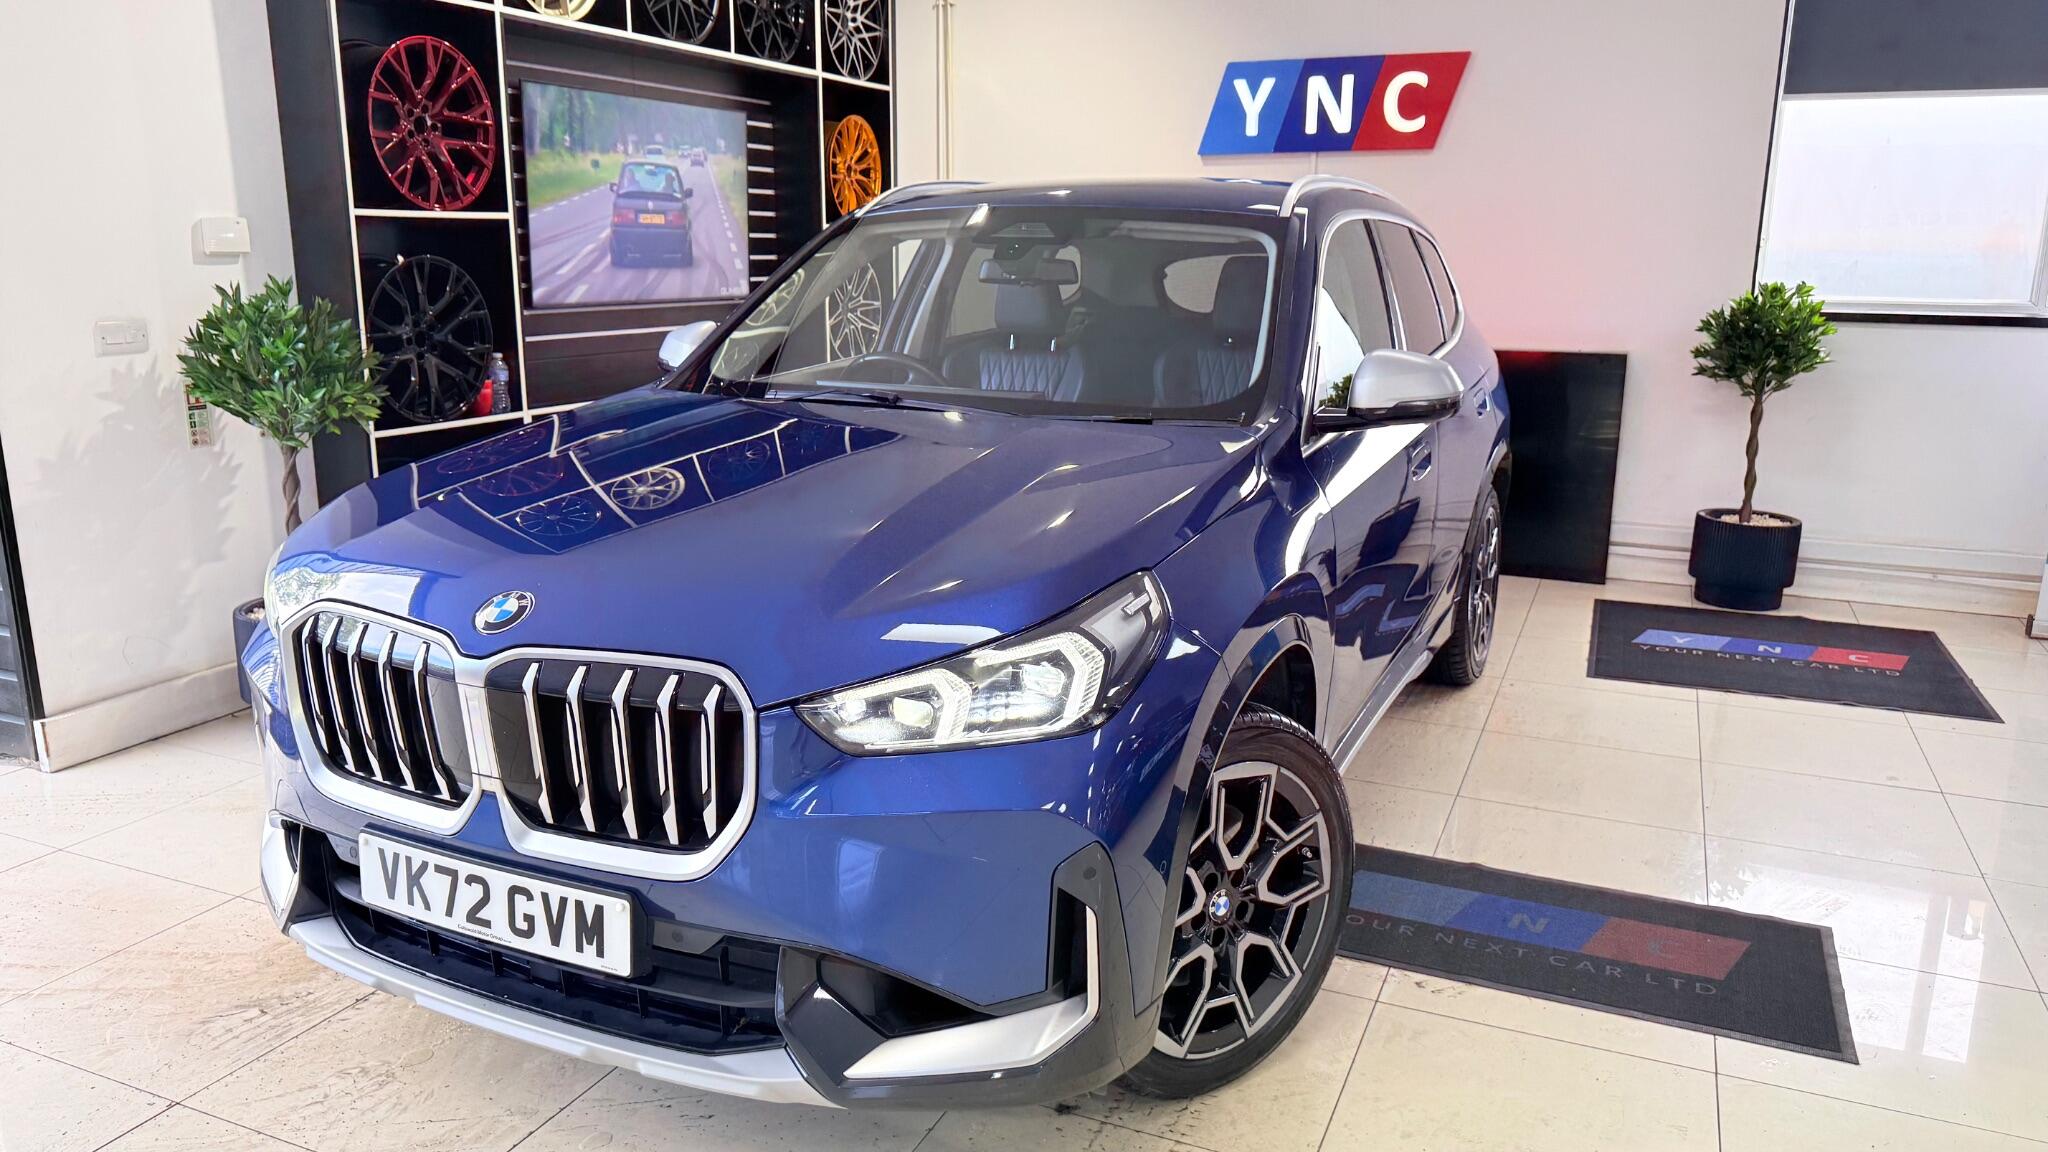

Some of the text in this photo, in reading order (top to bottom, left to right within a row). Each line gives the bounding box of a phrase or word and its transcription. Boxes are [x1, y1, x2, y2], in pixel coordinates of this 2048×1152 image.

[1233, 70, 1429, 137] YNC
[1639, 644, 1900, 677] YOUR NEXT CAR LTD
[377, 847, 606, 960] VK72 GVM
[1345, 914, 1717, 995] OUR NEXT CAR LTD
